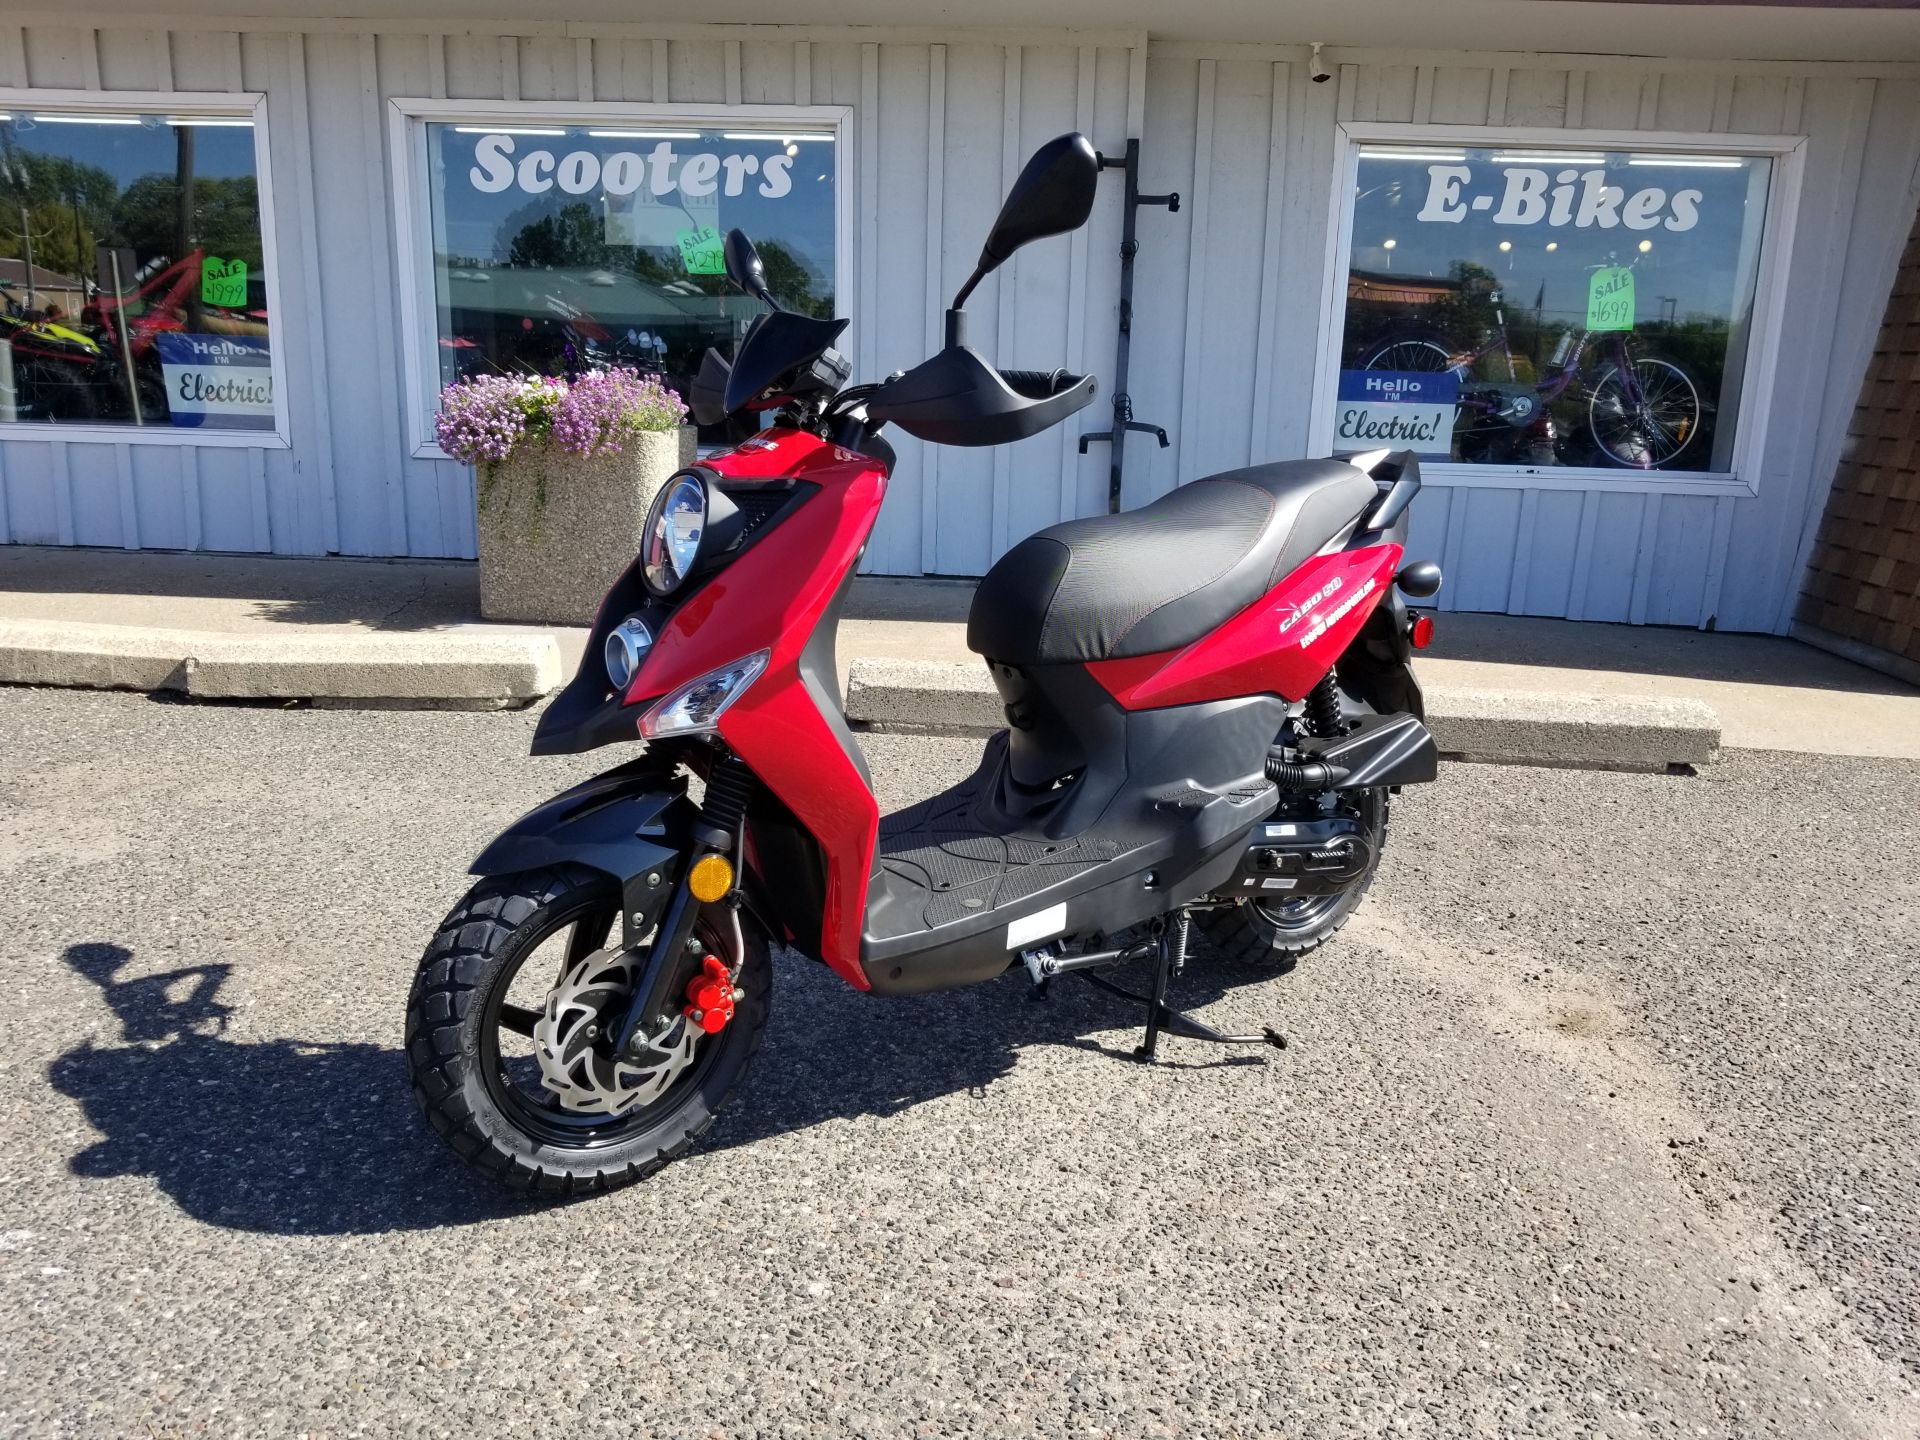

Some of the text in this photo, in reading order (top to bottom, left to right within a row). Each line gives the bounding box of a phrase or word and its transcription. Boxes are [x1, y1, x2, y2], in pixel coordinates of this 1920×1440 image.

[470, 135, 793, 198] Scooters
[1417, 166, 1703, 232] E-Bikes
[683, 228, 713, 250] SALE
[208, 264, 241, 280] SALE
[1595, 272, 1630, 300] SALE
[1591, 301, 1629, 322] $1699
[193, 342, 247, 355] Hello
[1366, 378, 1421, 392] Hello
[1385, 392, 1400, 401] I'M
[1339, 409, 1441, 441] Electric!
[1280, 592, 1323, 633] CABO
